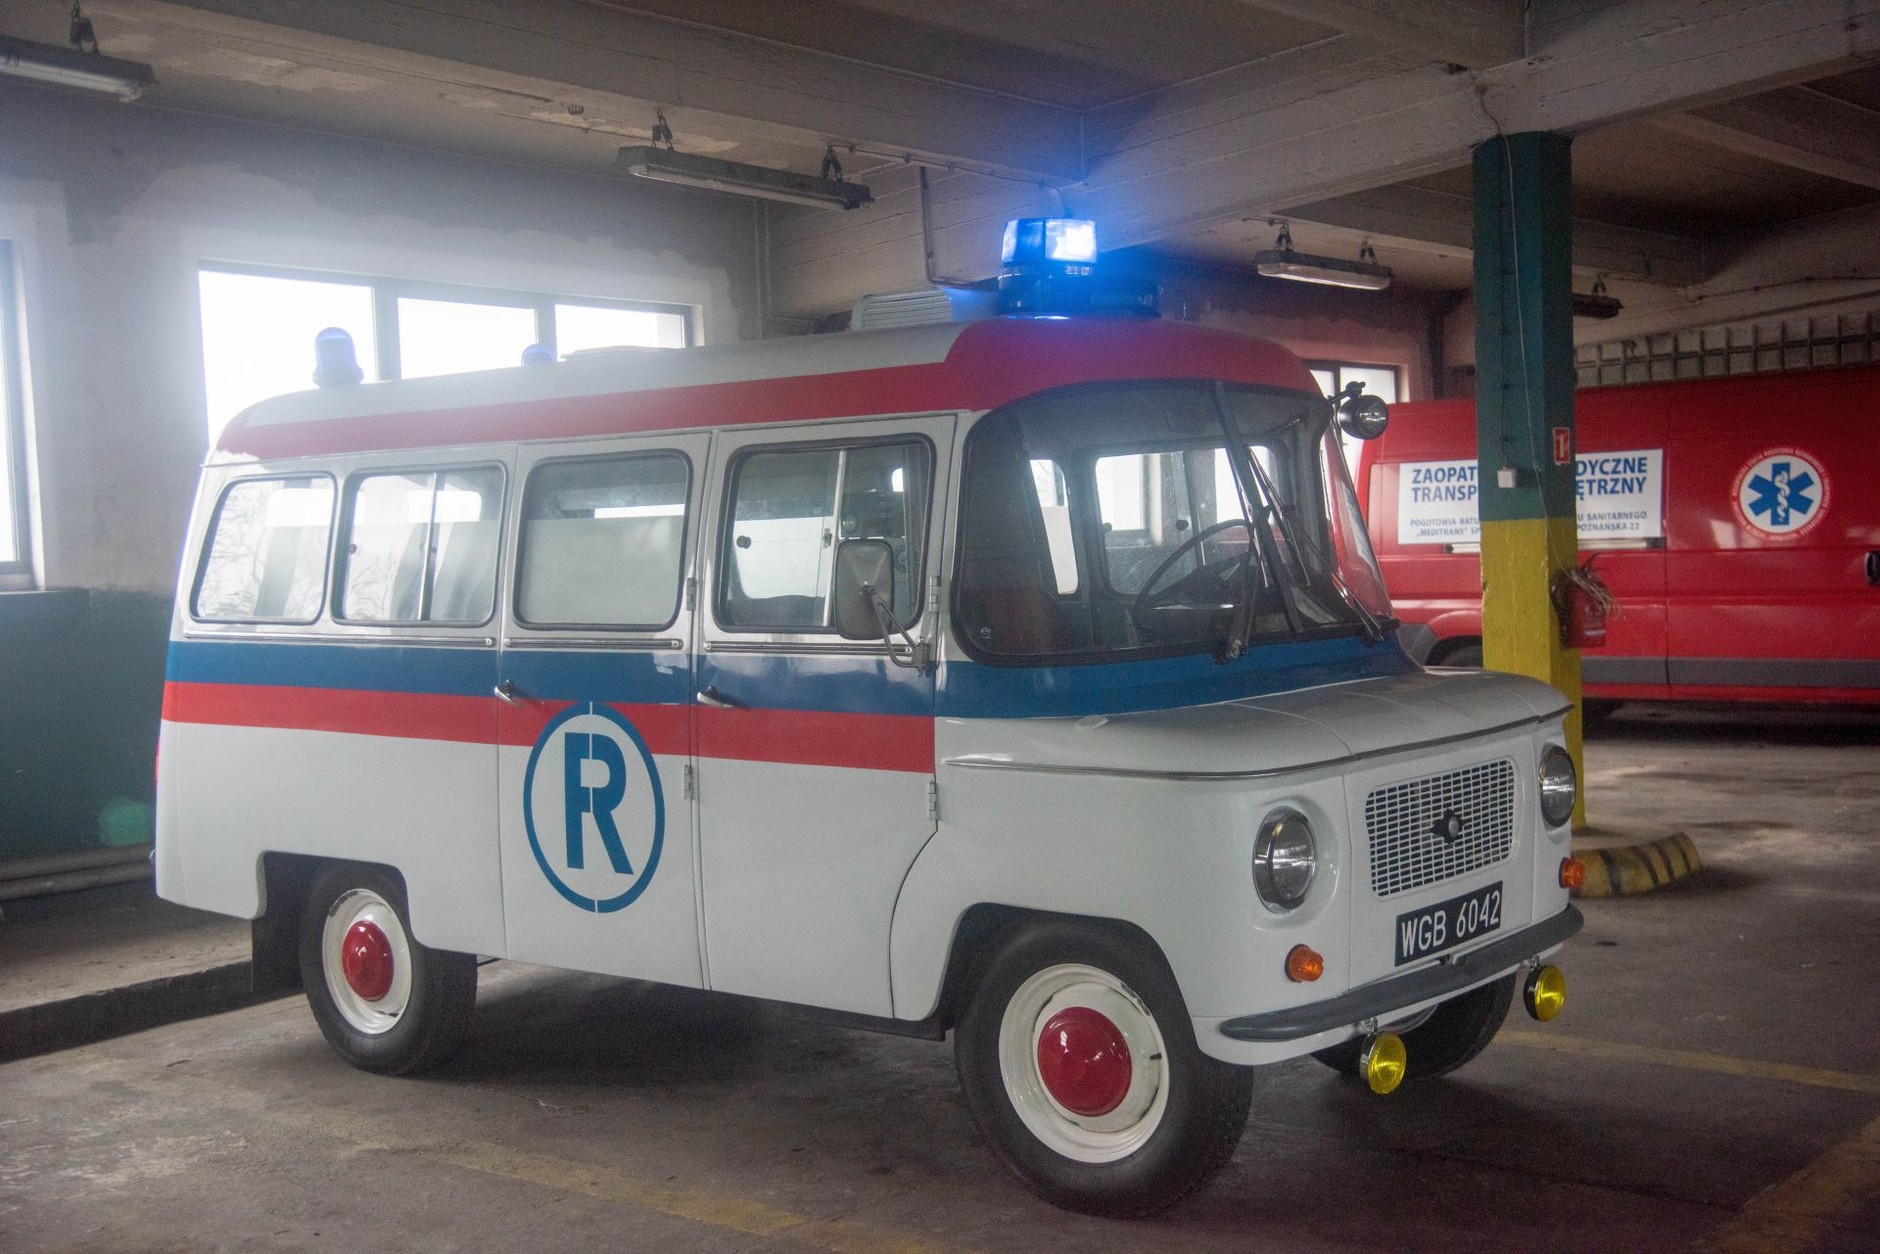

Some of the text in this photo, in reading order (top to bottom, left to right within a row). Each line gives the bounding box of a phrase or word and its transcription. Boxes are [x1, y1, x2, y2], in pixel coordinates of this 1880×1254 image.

[1412, 457, 1647, 484] ZAOPAT DYCZNE
[1412, 477, 1646, 502] TRANSP ĘTRZNY
[1586, 511, 1647, 521] SANITARNEGO
[564, 732, 634, 875] R
[1401, 890, 1500, 957] WGB 6042
